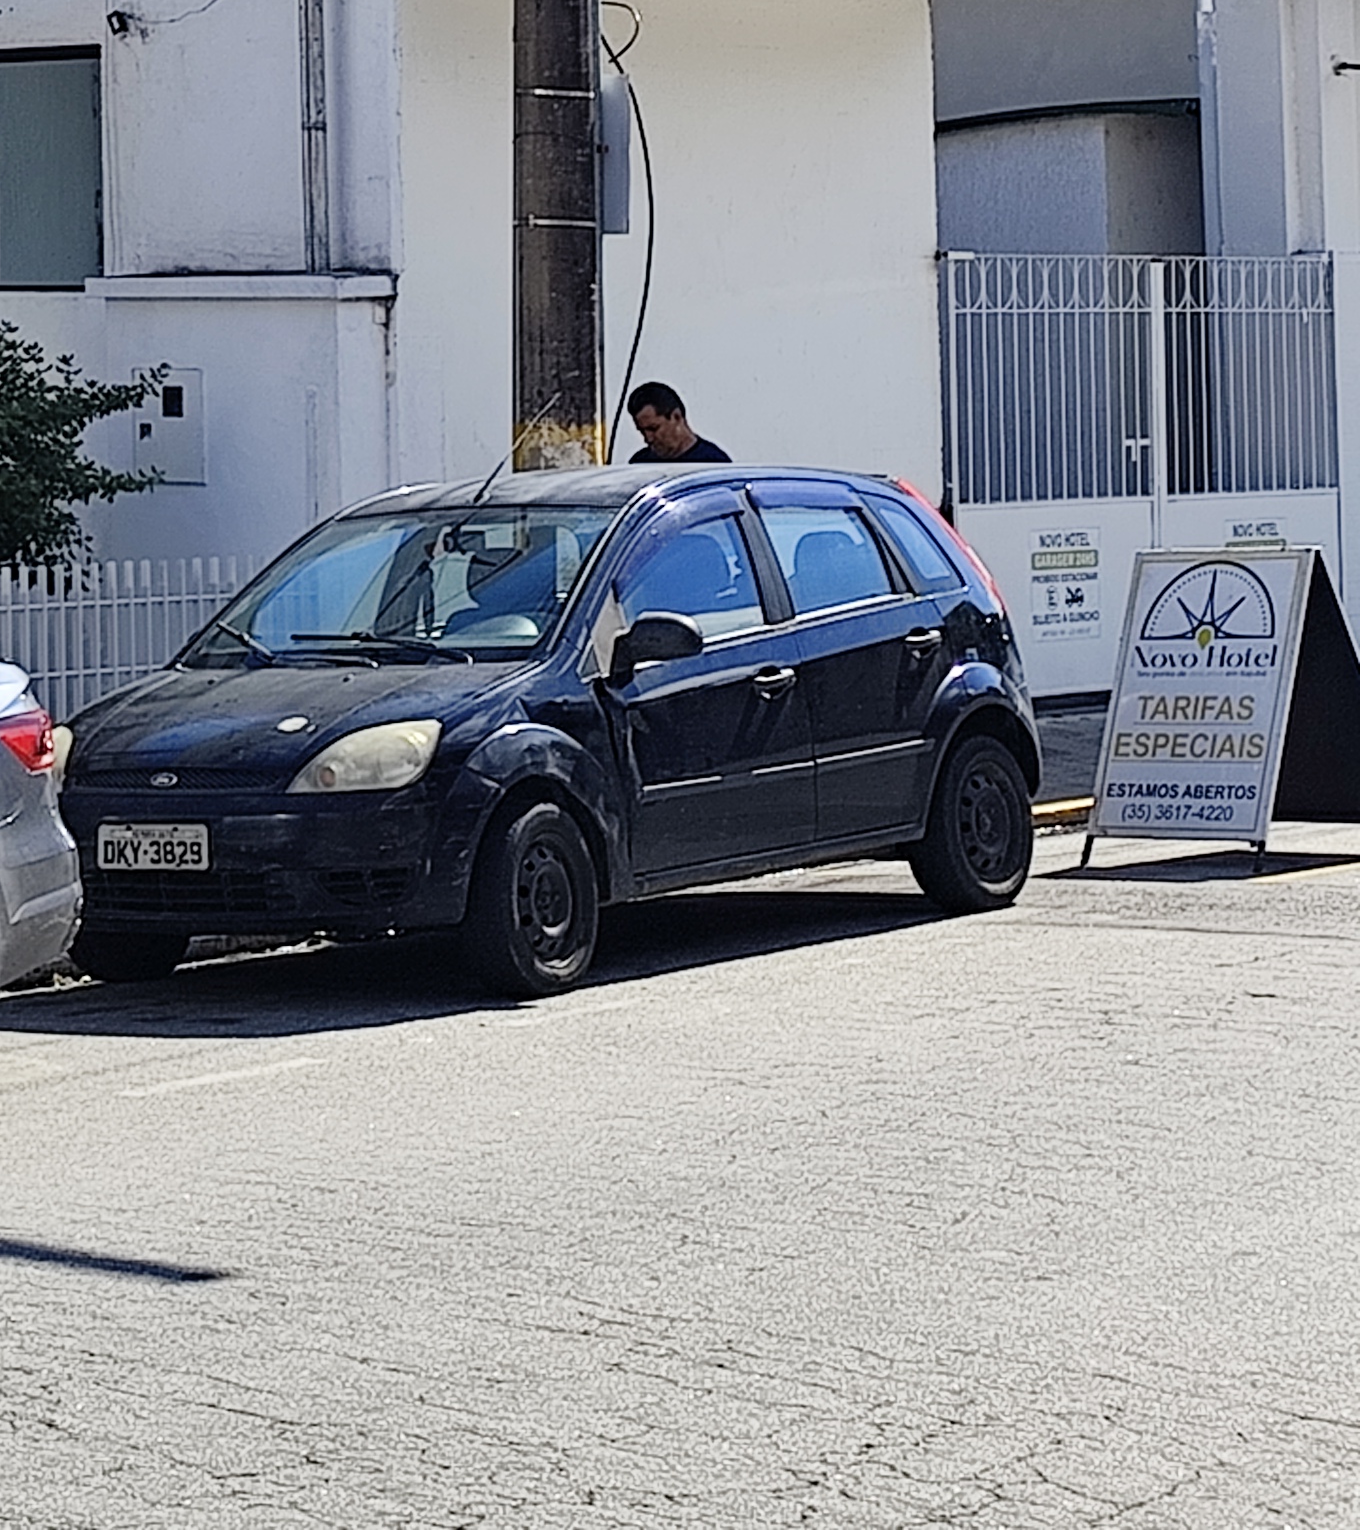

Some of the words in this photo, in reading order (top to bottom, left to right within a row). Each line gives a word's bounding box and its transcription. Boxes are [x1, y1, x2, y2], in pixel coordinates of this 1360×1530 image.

[1132, 645, 1198, 668] Novo
[1206, 644, 1278, 668] Hotel
[1138, 696, 1255, 720] TARIFAS
[1114, 733, 1265, 758] ESPECIAIS
[1106, 783, 1179, 798] ESTAMOS
[1182, 784, 1256, 800] ABERTOS
[1121, 803, 1151, 822] (35)
[1154, 803, 1234, 821] 3617-4220
